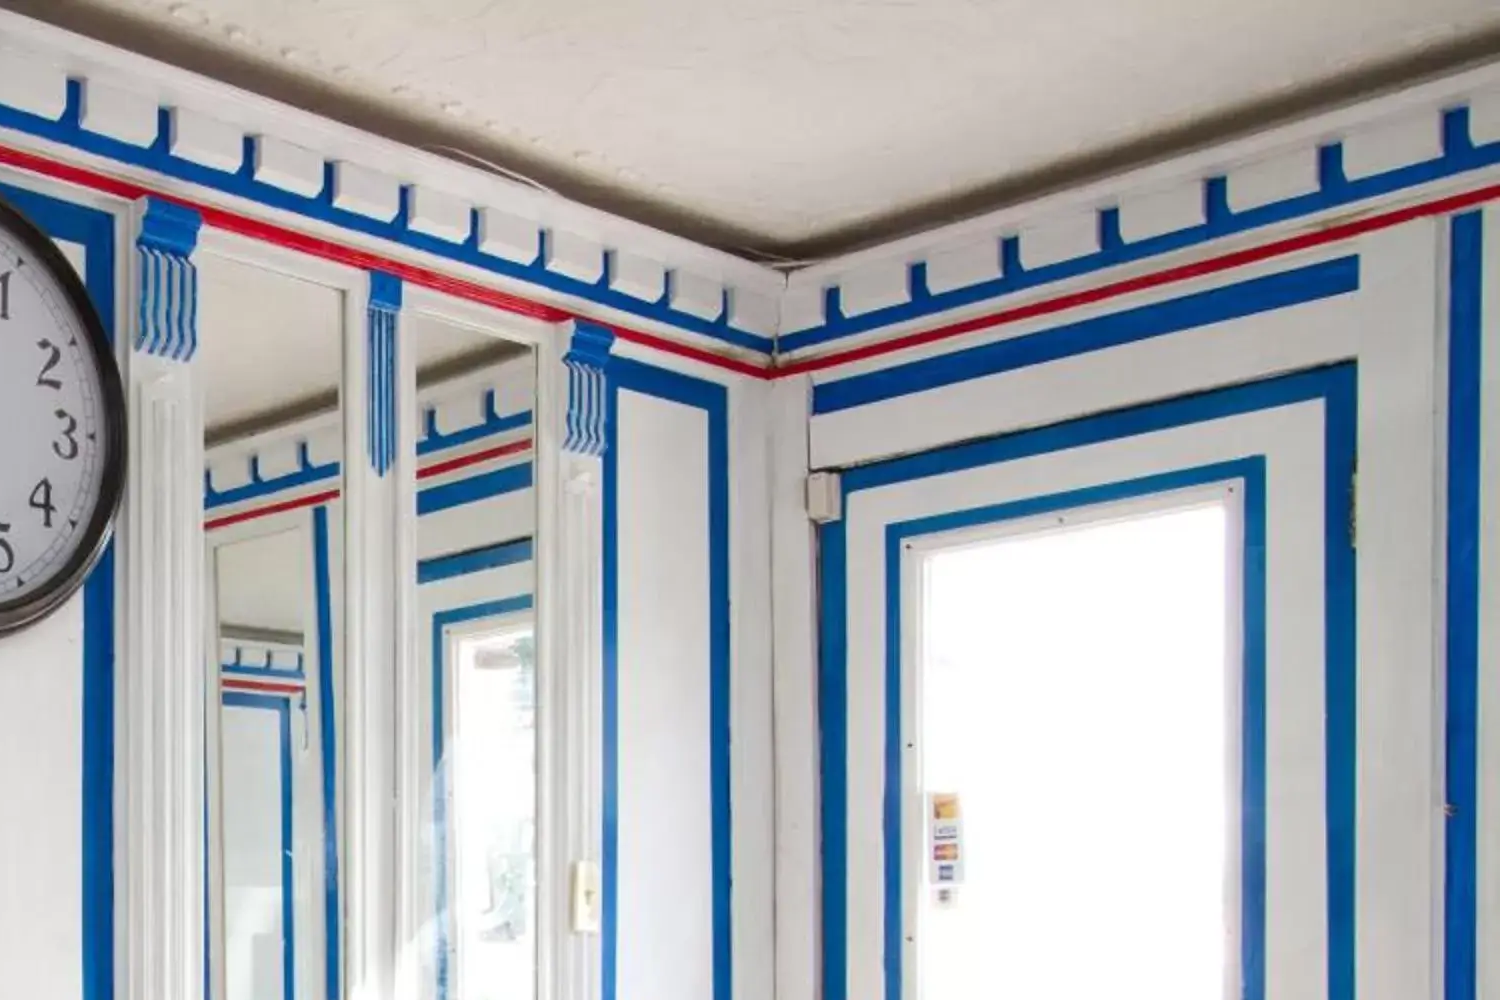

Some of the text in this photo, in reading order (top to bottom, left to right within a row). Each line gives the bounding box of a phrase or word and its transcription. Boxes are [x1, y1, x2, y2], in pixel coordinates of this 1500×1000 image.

[36, 338, 62, 390] 2
[52, 409, 78, 459] 3
[29, 477, 57, 528] 4
